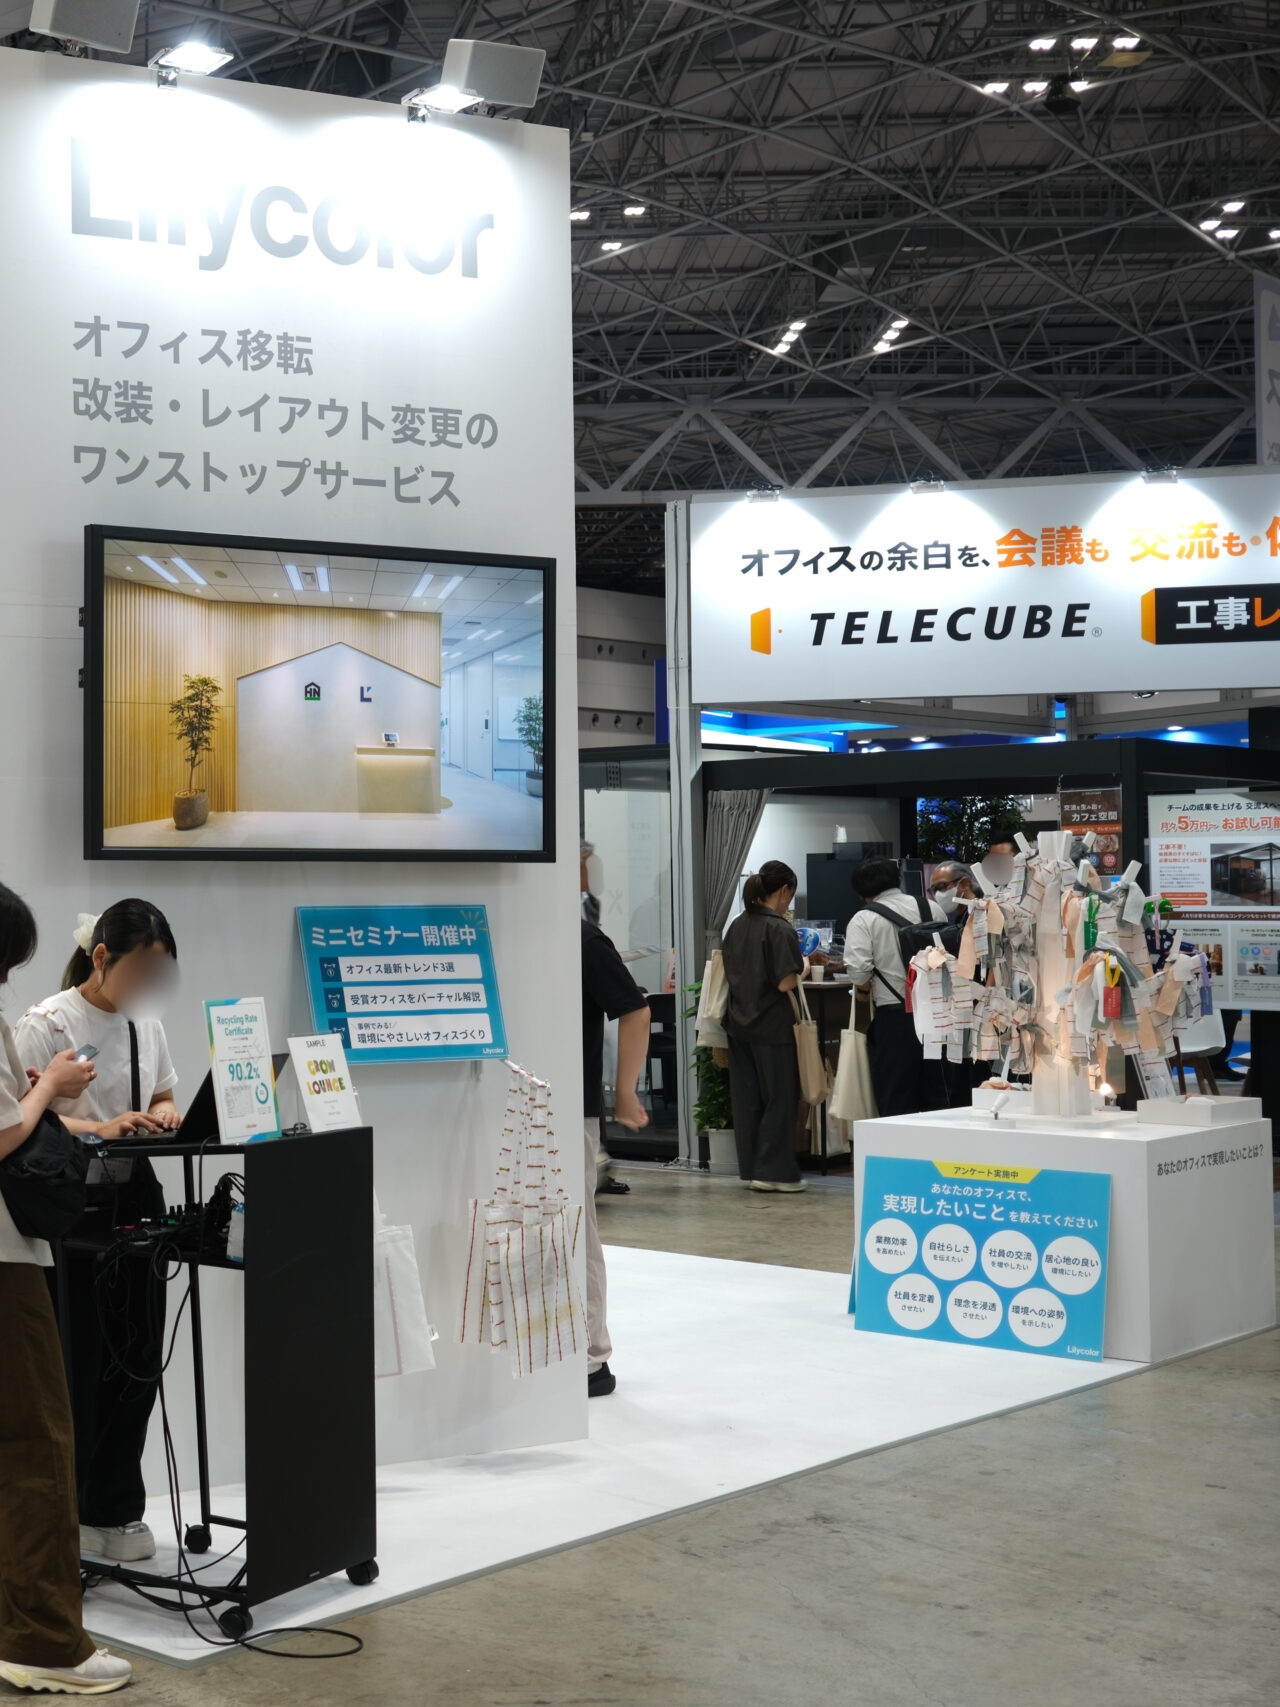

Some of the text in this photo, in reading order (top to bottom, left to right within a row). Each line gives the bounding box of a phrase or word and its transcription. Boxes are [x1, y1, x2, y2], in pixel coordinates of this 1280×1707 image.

[73, 315, 314, 376] オフィス移転
[72, 377, 499, 450] 改装・レイアウト変更の
[73, 445, 461, 508] ワンストップサービス
[810, 603, 1091, 646] TELECUBE
[1167, 803, 1243, 812] チームの成果を上げる
[1071, 811, 1119, 822] カフェ空間
[311, 924, 478, 947] ミニセミナー開催中
[346, 961, 455, 976] オフィス最新トレンド3選
[350, 990, 481, 1006] 受賞オフィスをバーチャル解説
[216, 1013, 258, 1026] Recycling Rate
[224, 1025, 253, 1037] Certificate
[357, 1031, 486, 1045] 環境にやさしいオフィスづくり
[306, 1040, 326, 1049] SAMPLE
[228, 1061, 260, 1081] 90.2%
[307, 1059, 336, 1076] GROW
[307, 1077, 347, 1096] LOUNGE
[1157, 1143, 1264, 1177] あなたのオフィスで実現したいことは?
[953, 1165, 1019, 1180] アンケート実施中
[931, 1183, 1032, 1202] あなたのオフィスで、
[883, 1193, 1099, 1230] 実現したいこと を教えてください
[875, 1235, 908, 1247] 業務効率
[928, 1241, 970, 1254] 自社らしさ
[876, 1247, 906, 1257] を高めたい
[933, 1253, 964, 1264] を伝えたい
[988, 1248, 1032, 1262] 社員の交流
[991, 1260, 1029, 1272] を増やしたい
[1044, 1255, 1099, 1269] 居心地の良い
[1051, 1267, 1091, 1279] 環境にしたい
[894, 1290, 935, 1304] 社員を定着
[901, 1304, 926, 1314] させたい
[954, 1297, 997, 1313] 理念を浸透
[962, 1311, 988, 1322] させたい
[1011, 1304, 1065, 1321] 環境への姿勢
[1021, 1318, 1054, 1330] を示したい
[1067, 1344, 1100, 1358] Lilycolor
